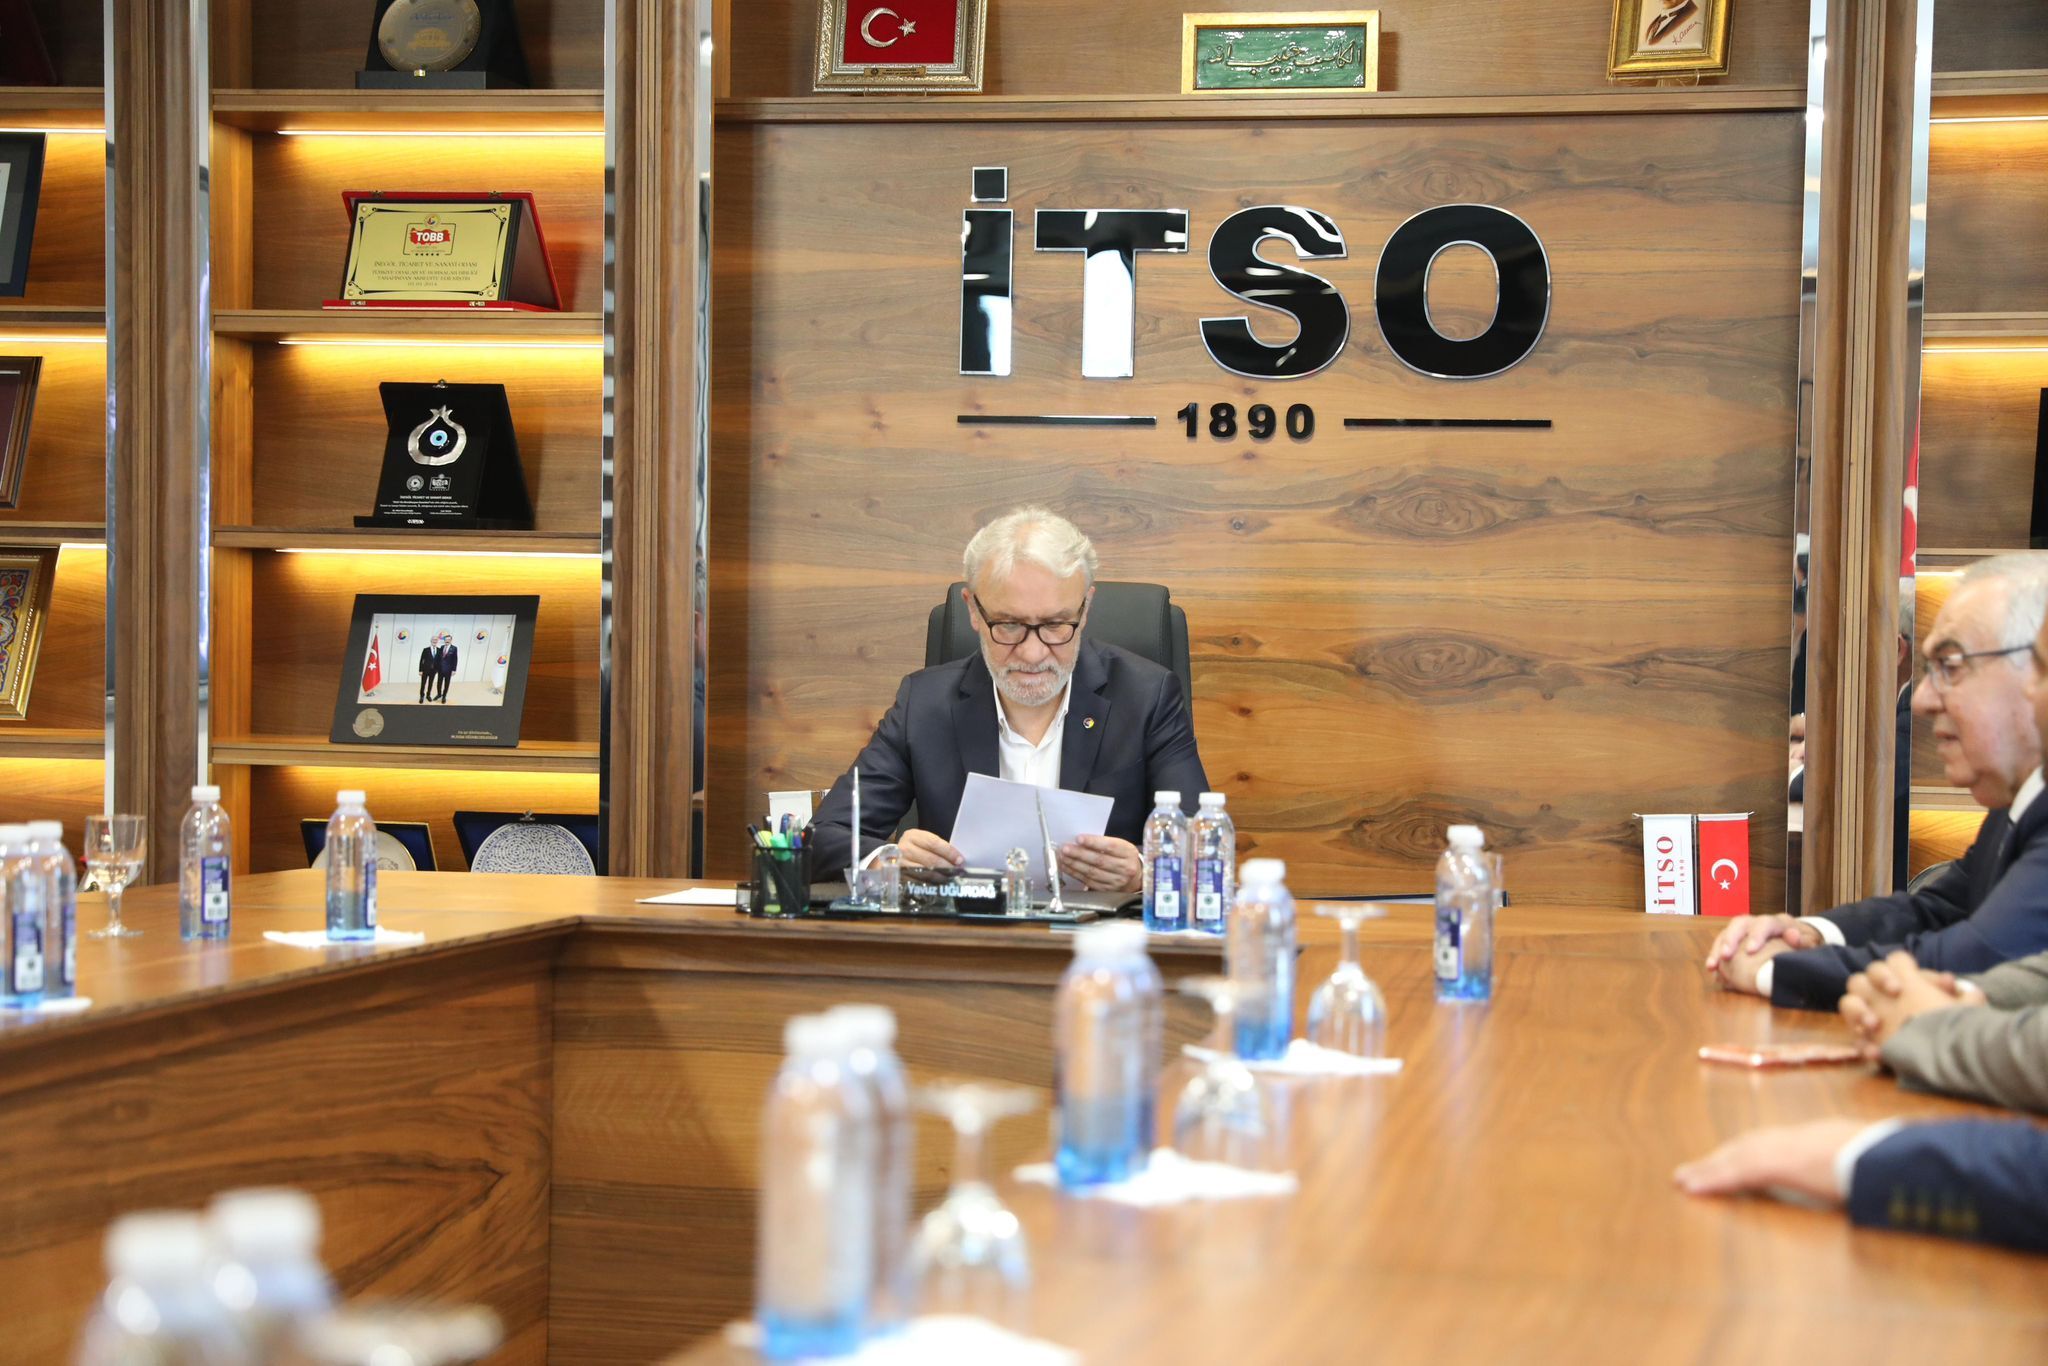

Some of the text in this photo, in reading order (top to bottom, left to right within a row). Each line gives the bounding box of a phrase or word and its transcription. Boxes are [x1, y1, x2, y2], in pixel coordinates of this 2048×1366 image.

[415, 232, 444, 242] TOBB
[959, 166, 1552, 379] İTSO
[1177, 402, 1315, 440] 1890
[908, 883, 938, 895] Yavuz
